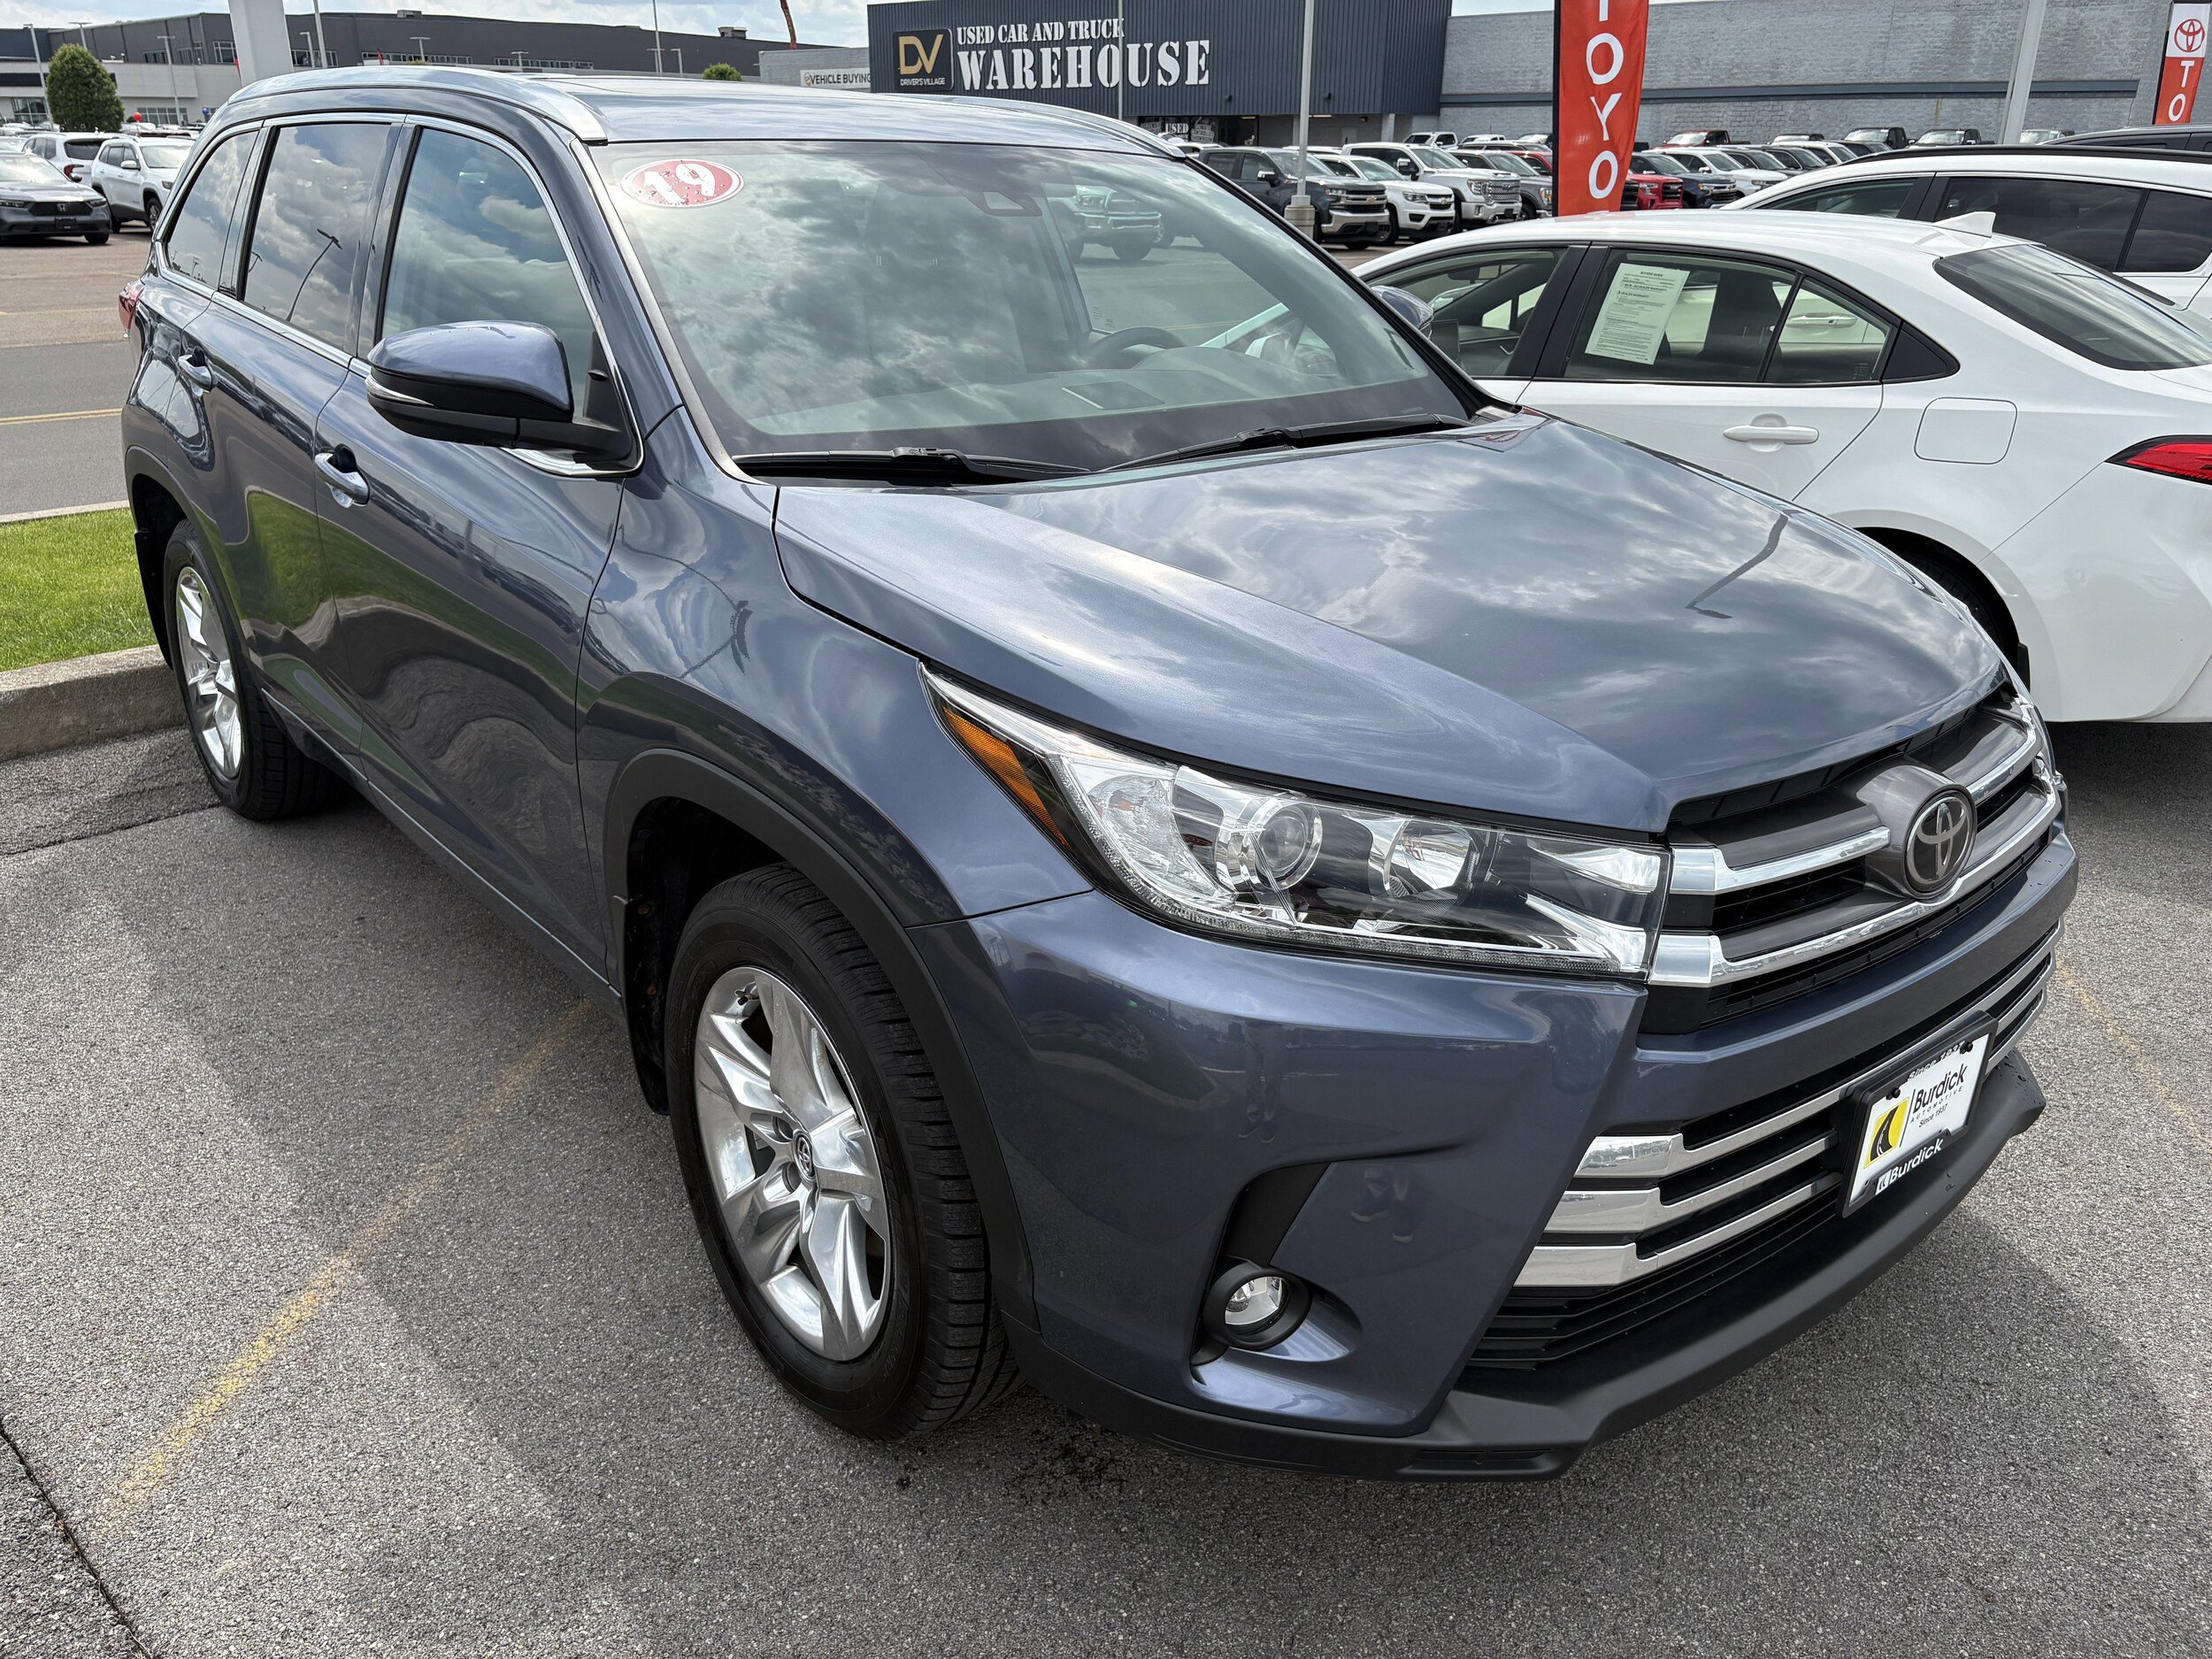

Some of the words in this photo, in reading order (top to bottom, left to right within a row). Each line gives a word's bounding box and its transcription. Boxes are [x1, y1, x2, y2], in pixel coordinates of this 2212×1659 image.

[956, 26, 995, 44] USED
[997, 23, 1029, 43] CAR
[1032, 21, 1064, 42] AND
[1067, 18, 1125, 40] TRUCK
[899, 34, 944, 74] DV
[956, 40, 1210, 90] WAREHOUSE
[810, 73, 841, 85] VEHICLE
[923, 77, 946, 86] VILLAGE
[1165, 123, 1189, 134] USED
[643, 163, 716, 205] 19
[1910, 1086, 1962, 1124] AUTOMOTIVE
[1913, 1063, 1968, 1114] Burdick
[1918, 1113, 1934, 1128] Since
[1889, 1138, 1944, 1185] Burdick
